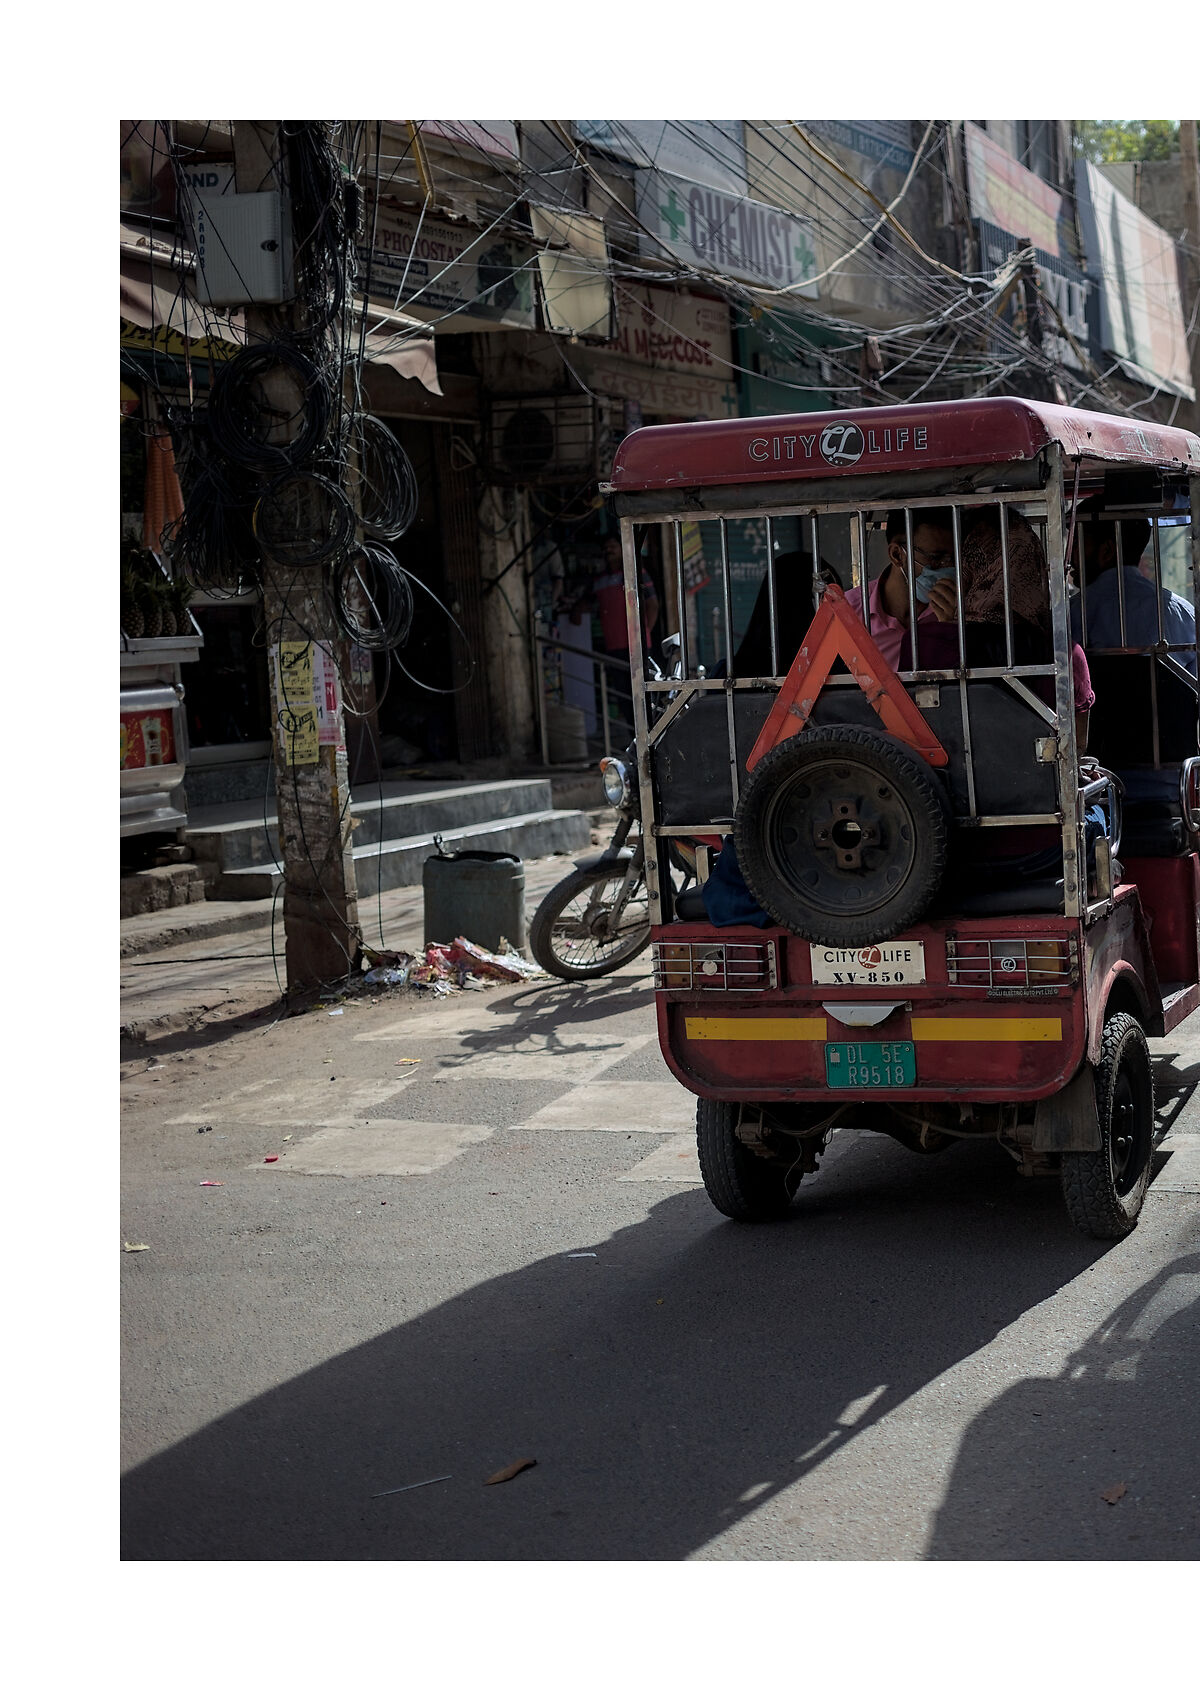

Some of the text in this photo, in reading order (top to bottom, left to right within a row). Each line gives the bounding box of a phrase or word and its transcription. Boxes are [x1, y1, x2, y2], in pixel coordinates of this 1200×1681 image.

[688, 186, 792, 284] CHEMIST
[748, 434, 816, 462] CITY
[867, 426, 928, 454] LIFE
[823, 950, 857, 963] CITY
[882, 950, 912, 962] LIFE
[832, 972, 904, 983] XV-850
[846, 1044, 903, 1064] DL 5E
[849, 1065, 905, 1086] R9518
